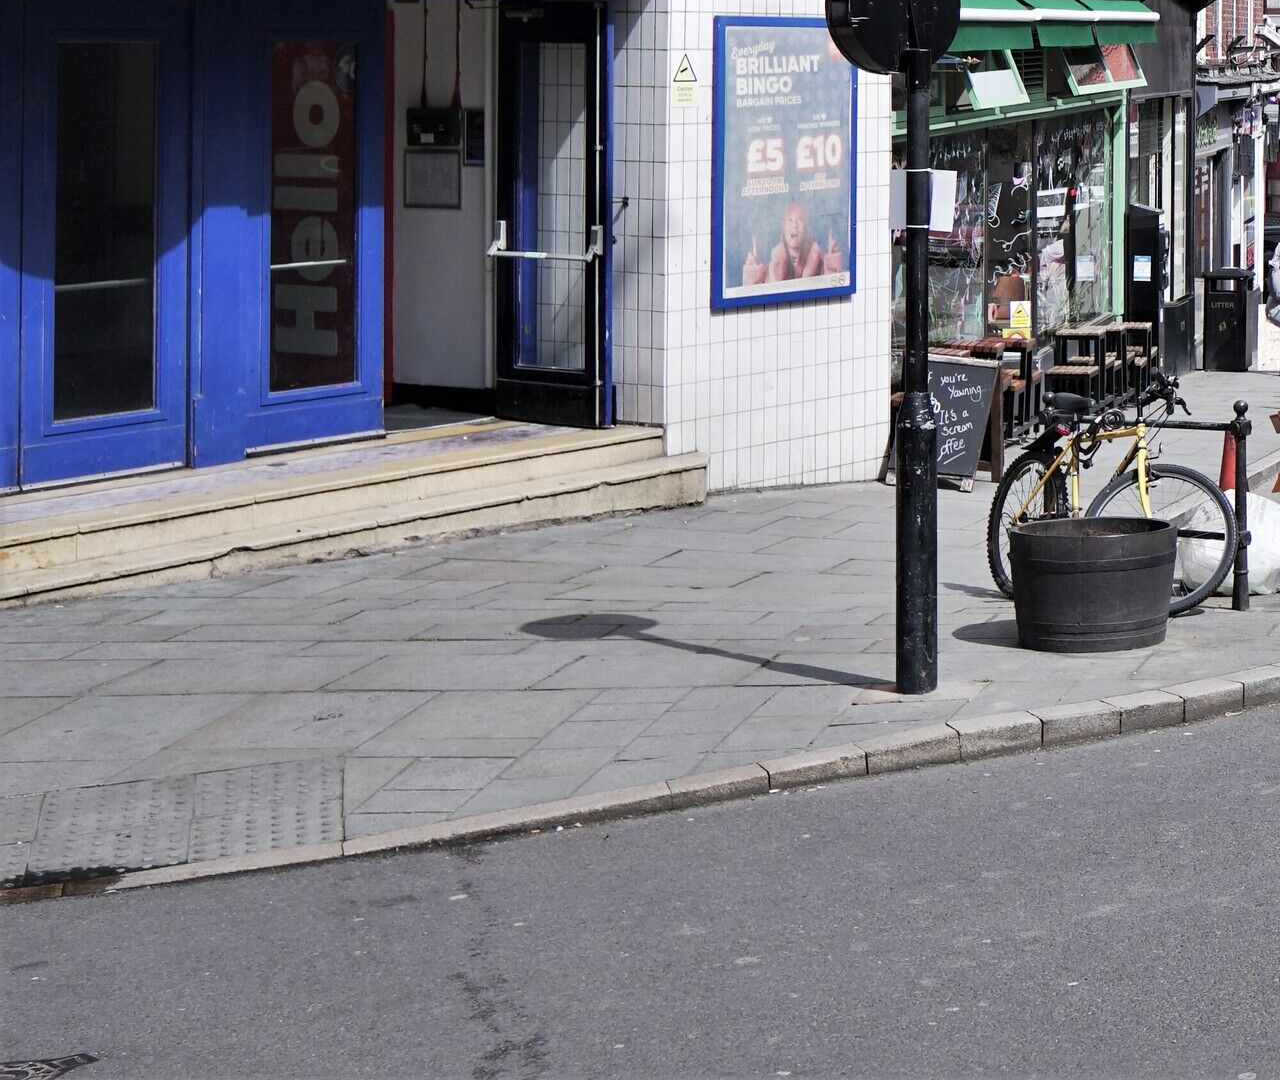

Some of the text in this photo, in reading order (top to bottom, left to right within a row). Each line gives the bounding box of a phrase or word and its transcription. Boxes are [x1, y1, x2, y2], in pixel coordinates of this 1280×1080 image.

[731, 41, 775, 59] Everyday
[736, 55, 820, 75] BRILLIANT
[736, 76, 792, 95] BINGO
[737, 95, 802, 108] BARGAIN PRICES
[747, 138, 784, 173] £5
[796, 134, 842, 169] £10
[274, 81, 340, 356] Hello
[1211, 301, 1235, 309] LITTER
[940, 373, 968, 386] you're
[939, 409, 969, 425] It's a
[941, 422, 973, 436] scream
[937, 438, 966, 461] offee
